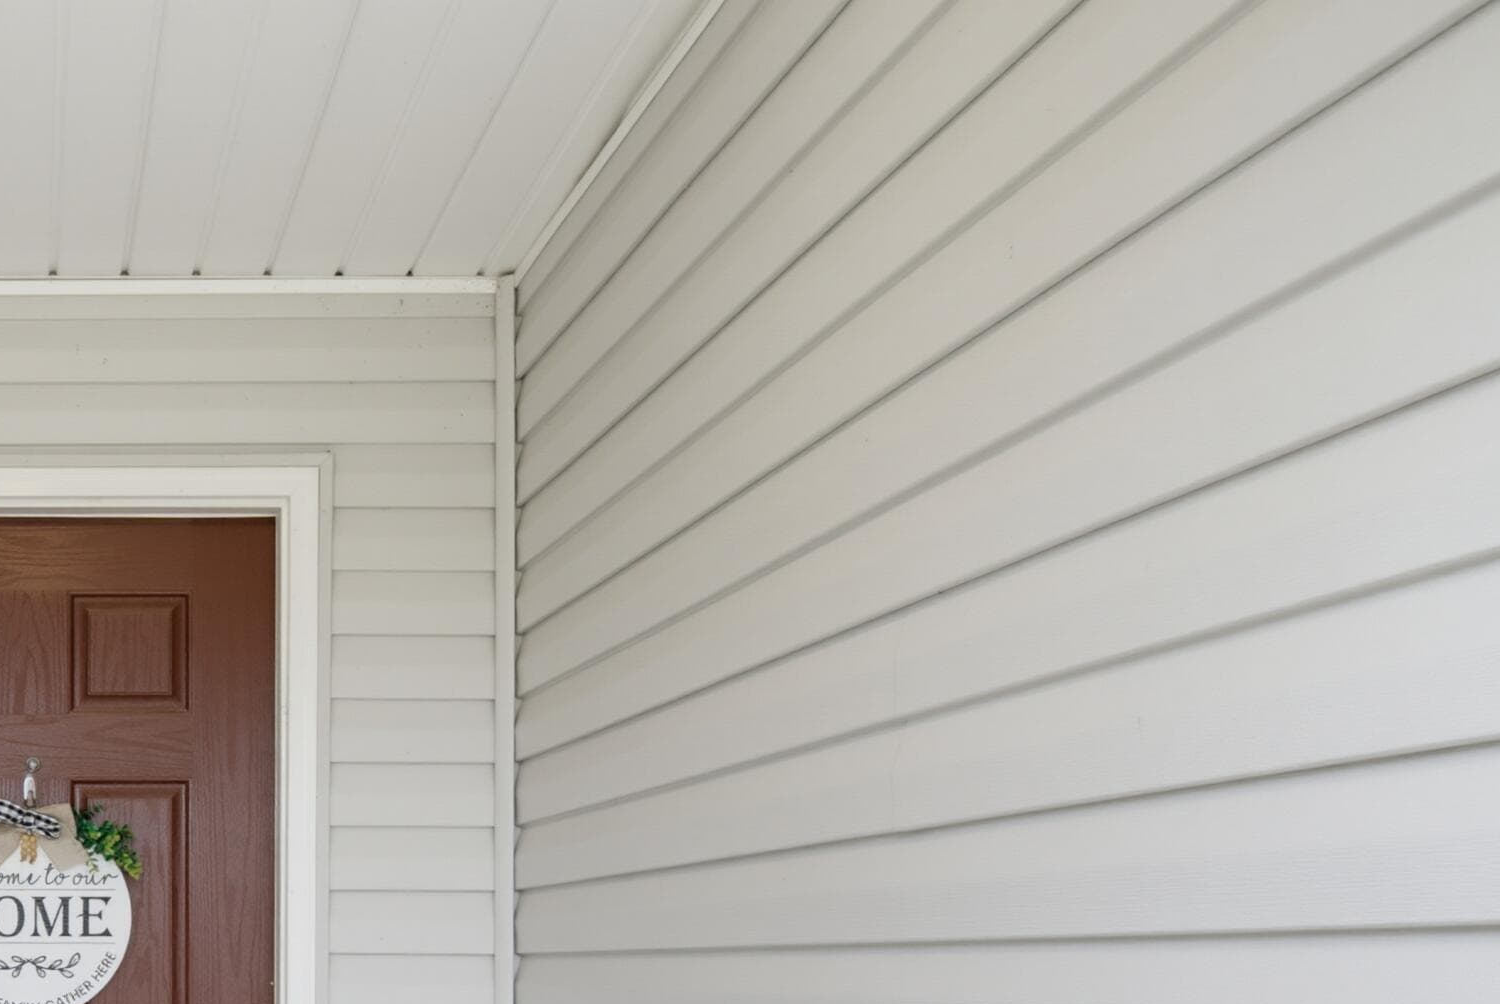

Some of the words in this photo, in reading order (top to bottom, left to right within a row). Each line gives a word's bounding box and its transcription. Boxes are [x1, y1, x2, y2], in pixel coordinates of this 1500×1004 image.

[44, 863, 68, 886] to
[72, 872, 118, 886] our
[92, 951, 117, 982] HERE
